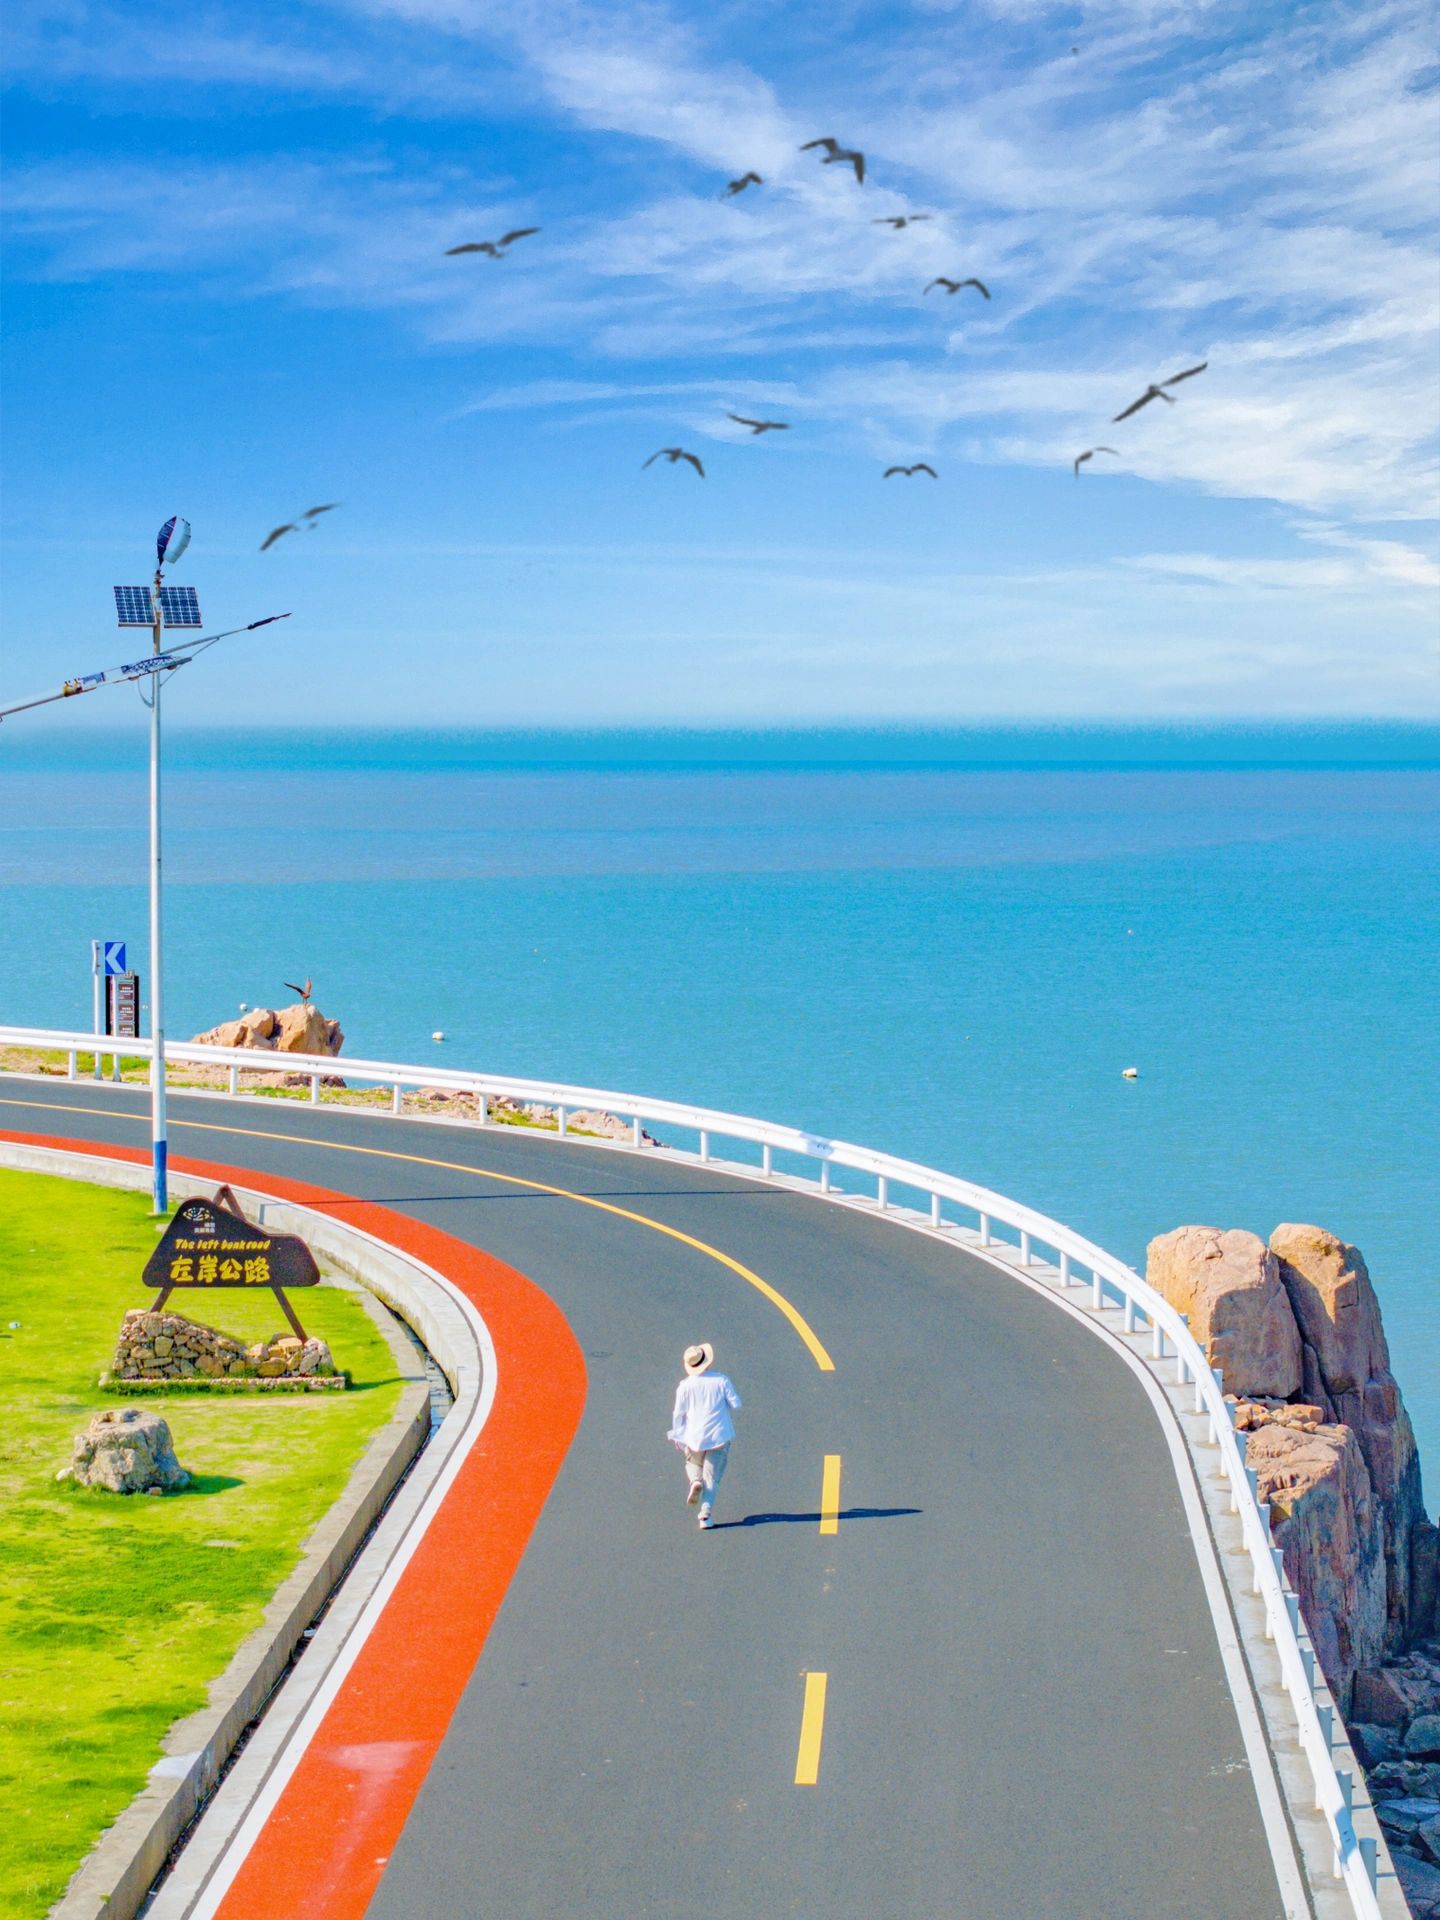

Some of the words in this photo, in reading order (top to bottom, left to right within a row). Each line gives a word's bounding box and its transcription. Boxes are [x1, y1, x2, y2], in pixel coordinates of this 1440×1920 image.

[175, 1239, 195, 1250] The
[197, 1239, 219, 1250] left
[170, 1254, 270, 1283] 左岸公路
